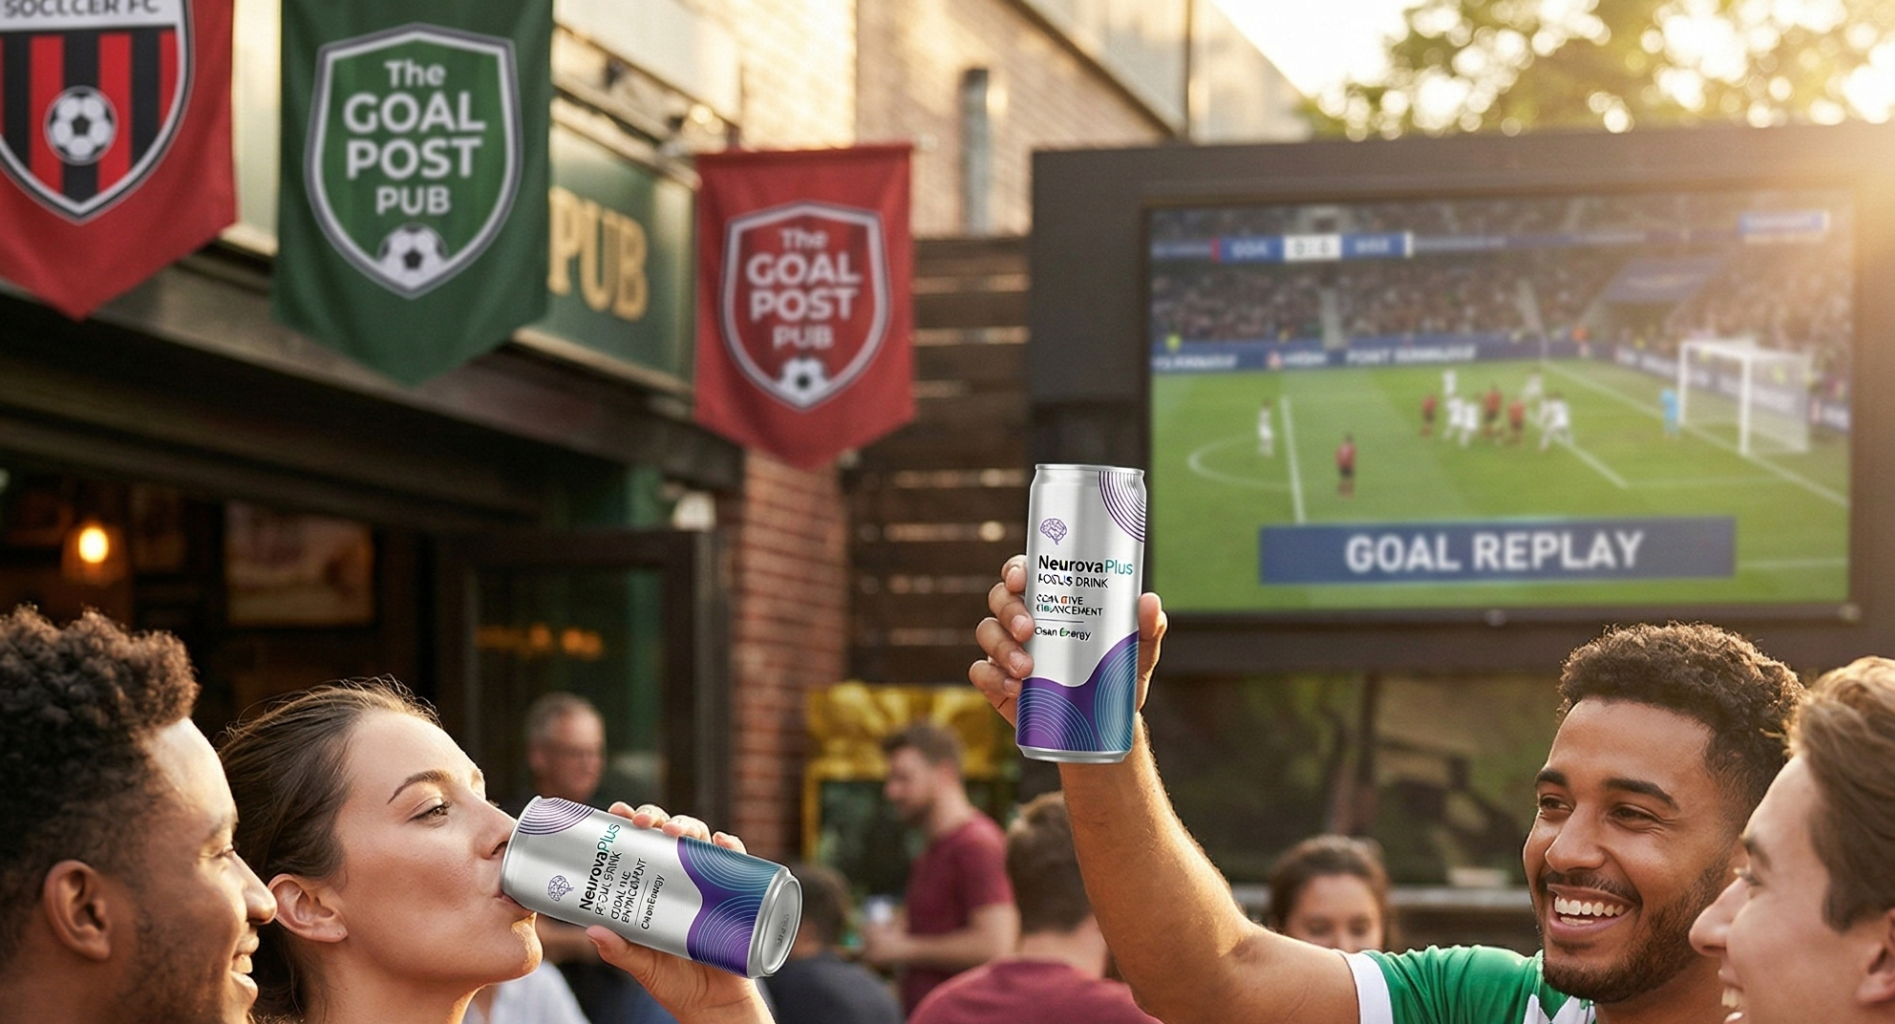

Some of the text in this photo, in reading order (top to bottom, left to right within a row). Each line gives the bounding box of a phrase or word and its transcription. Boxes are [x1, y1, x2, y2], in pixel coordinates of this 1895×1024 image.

[384, 59, 446, 88] The
[343, 91, 486, 134] GOAL
[346, 137, 482, 180] POST
[375, 185, 451, 216] PUB
[549, 184, 648, 321] PUB
[780, 228, 828, 249] The
[746, 251, 862, 288] GOAL
[750, 287, 857, 322] POST
[773, 325, 833, 349] PUB
[1039, 555, 1133, 575] NeurovaPlus
[1345, 531, 1644, 573] GOAL REPLAY
[1075, 577, 1108, 588] DRINK
